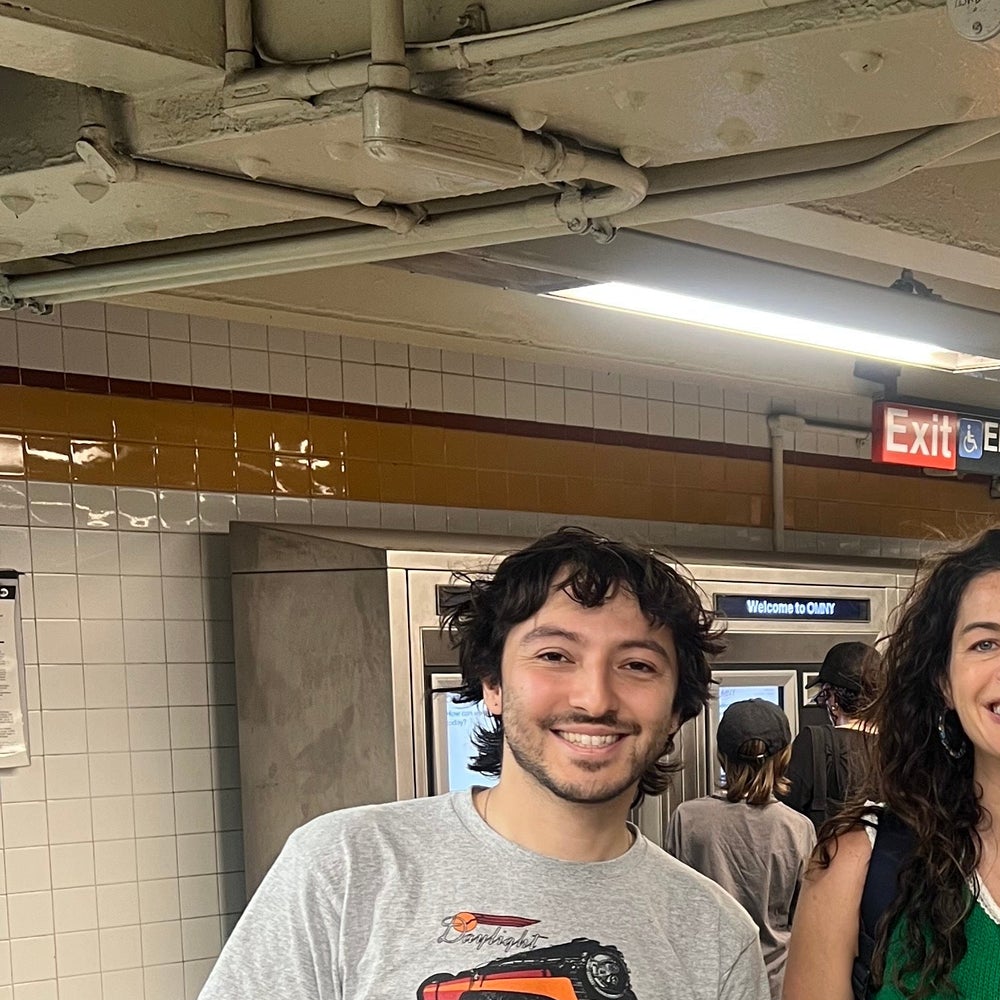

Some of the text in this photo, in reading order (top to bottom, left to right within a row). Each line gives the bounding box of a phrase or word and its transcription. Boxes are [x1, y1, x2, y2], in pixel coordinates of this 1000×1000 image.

[886, 407, 953, 459] Exit
[746, 599, 836, 615] Welcome to OMNY
[437, 915, 549, 953] Daylight
